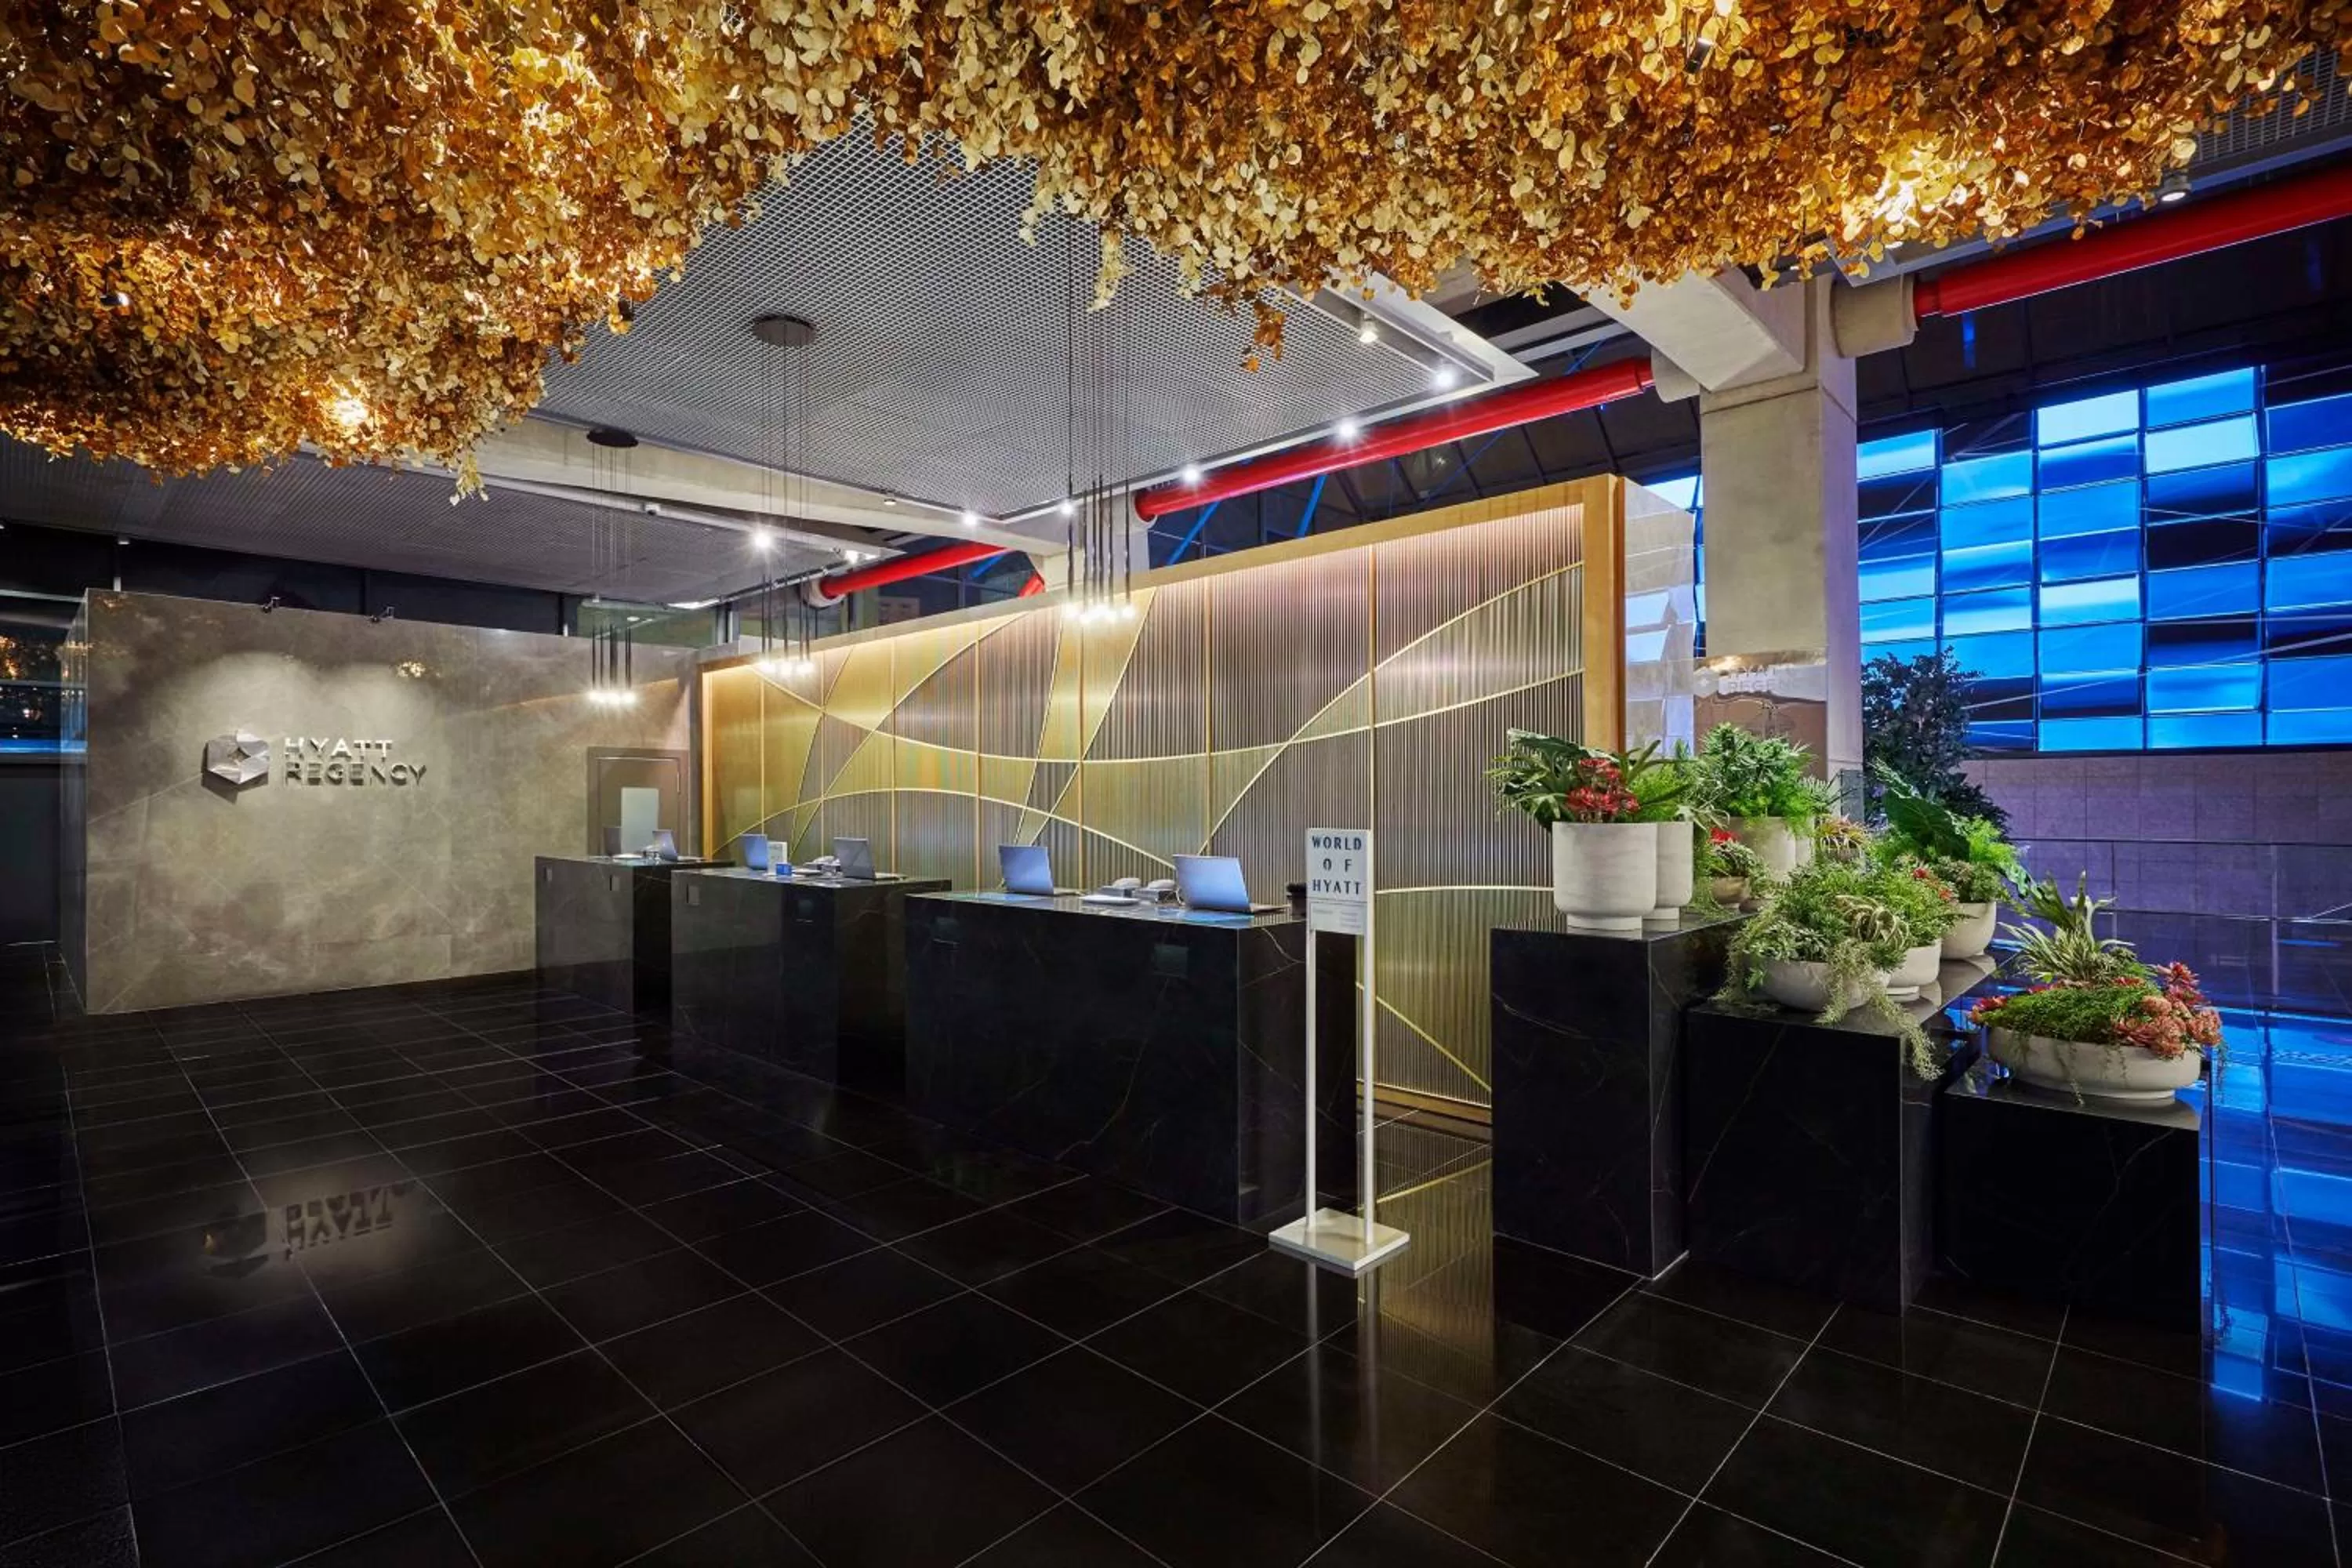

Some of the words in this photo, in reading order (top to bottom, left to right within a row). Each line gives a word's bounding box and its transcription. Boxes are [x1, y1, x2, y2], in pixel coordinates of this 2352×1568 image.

[285, 737, 393, 760] HYATT
[285, 761, 427, 786] REGENCY
[1312, 836, 1362, 851] WORLD
[1323, 858, 1352, 873] OF
[1312, 879, 1361, 895] HYATT
